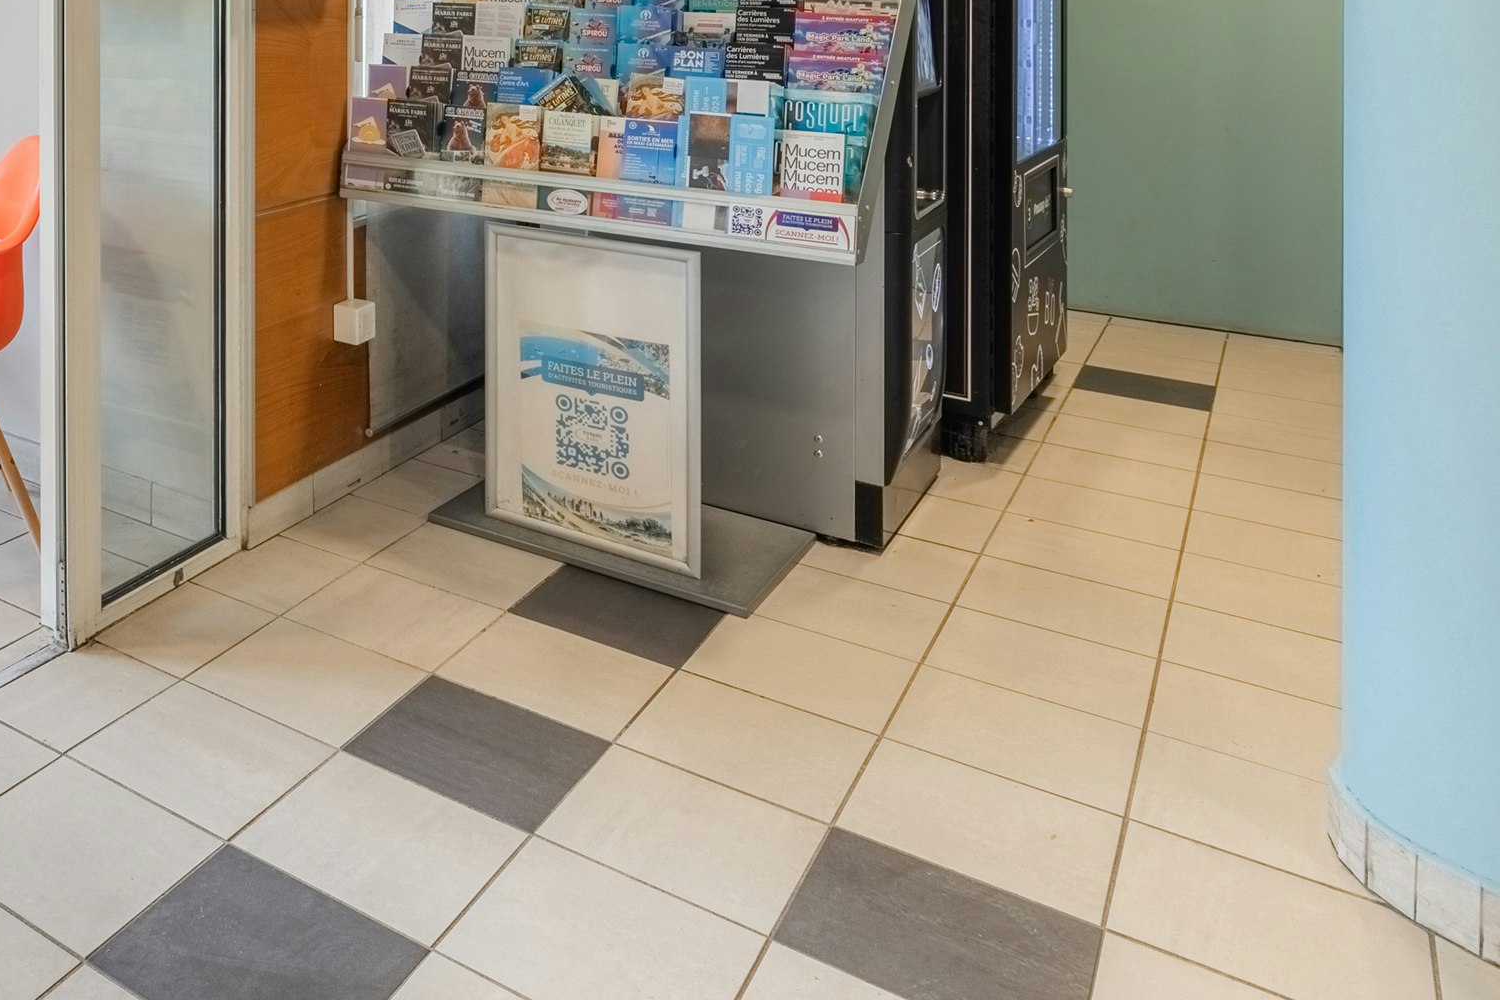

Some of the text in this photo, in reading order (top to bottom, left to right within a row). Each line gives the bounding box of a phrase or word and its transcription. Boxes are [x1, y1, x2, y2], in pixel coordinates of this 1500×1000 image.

[581, 29, 608, 37] SPIROU
[807, 32, 871, 42] Magic Park Land
[464, 46, 506, 58] Mucem
[680, 50, 704, 59] BON
[464, 57, 504, 68] Mucem
[674, 58, 704, 67] PLAN
[797, 70, 862, 81] Magic Park Land
[548, 118, 586, 128] CALANQUET
[627, 135, 651, 143] SORTIES
[785, 143, 841, 160] Mucem
[784, 156, 840, 173] Mucem
[783, 169, 839, 186] Mucem
[782, 213, 833, 226] FAITES LE PLEIN
[775, 228, 836, 242] SCANNEZ-MOI
[547, 361, 637, 387] FAITES LE PLEIN
[548, 372, 638, 396] D'ACTIVITÉS TOURISTIQUES
[551, 469, 630, 496] SCANNEZ-MOI
